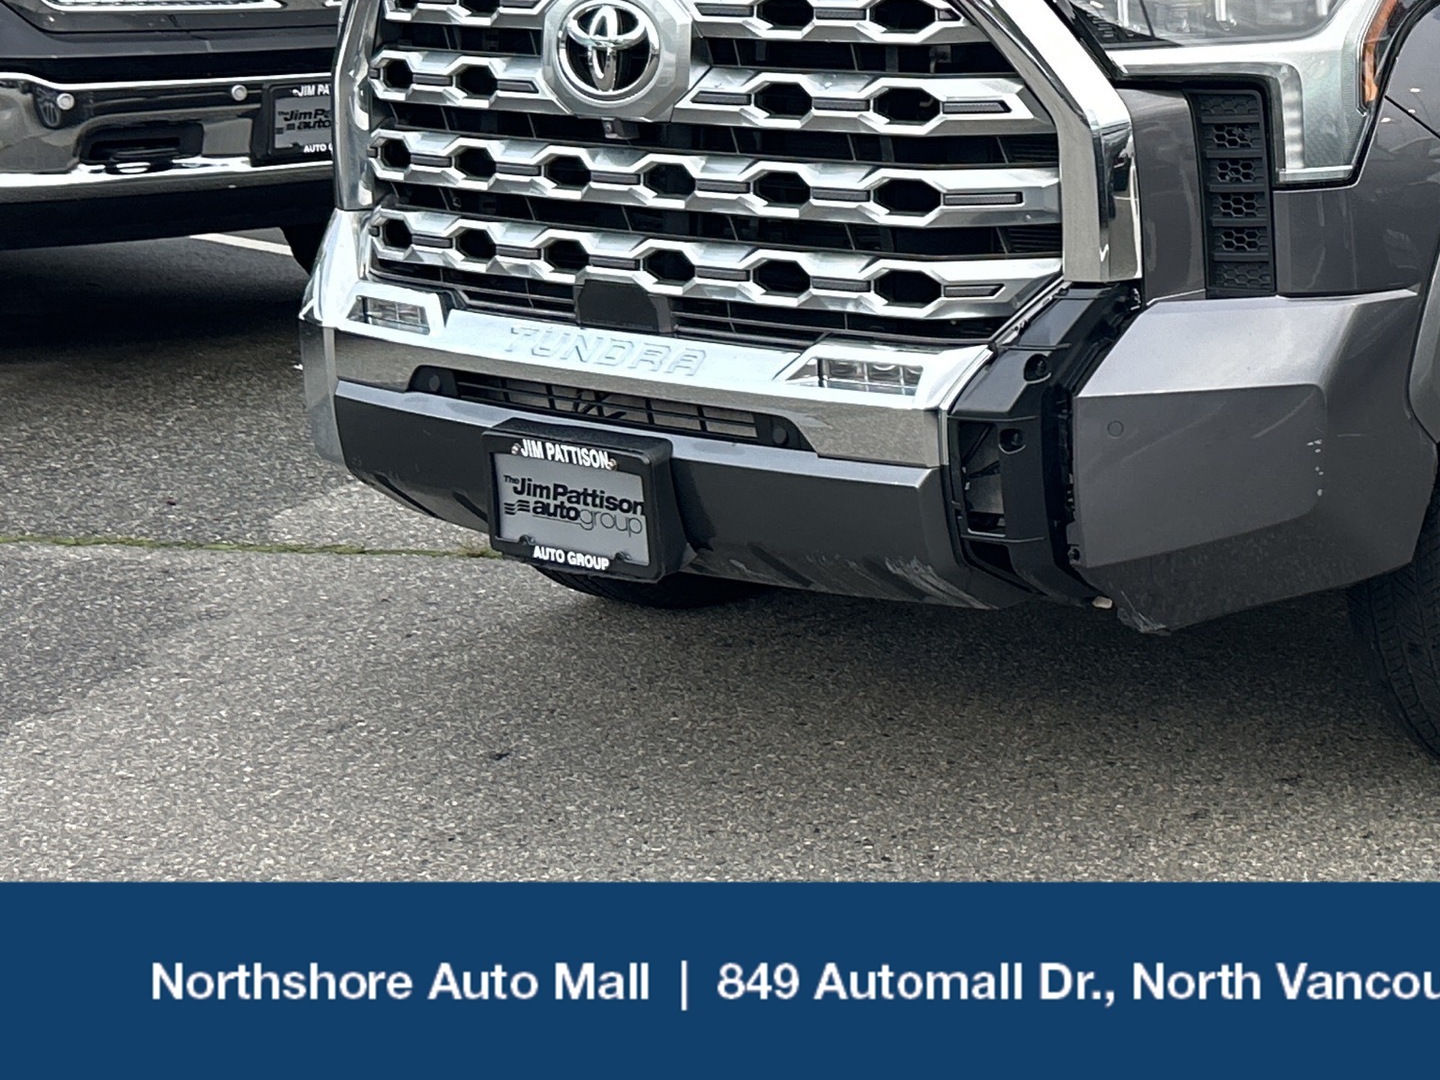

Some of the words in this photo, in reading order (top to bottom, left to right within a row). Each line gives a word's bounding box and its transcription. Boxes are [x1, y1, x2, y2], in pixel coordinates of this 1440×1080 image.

[303, 144, 327, 153] AUTO
[504, 327, 706, 376] TUNDRA
[520, 438, 544, 460] JIM
[546, 441, 611, 469] PATTISON
[503, 474, 520, 485] The
[533, 545, 565, 562] AUTO
[567, 551, 610, 570] GROUP
